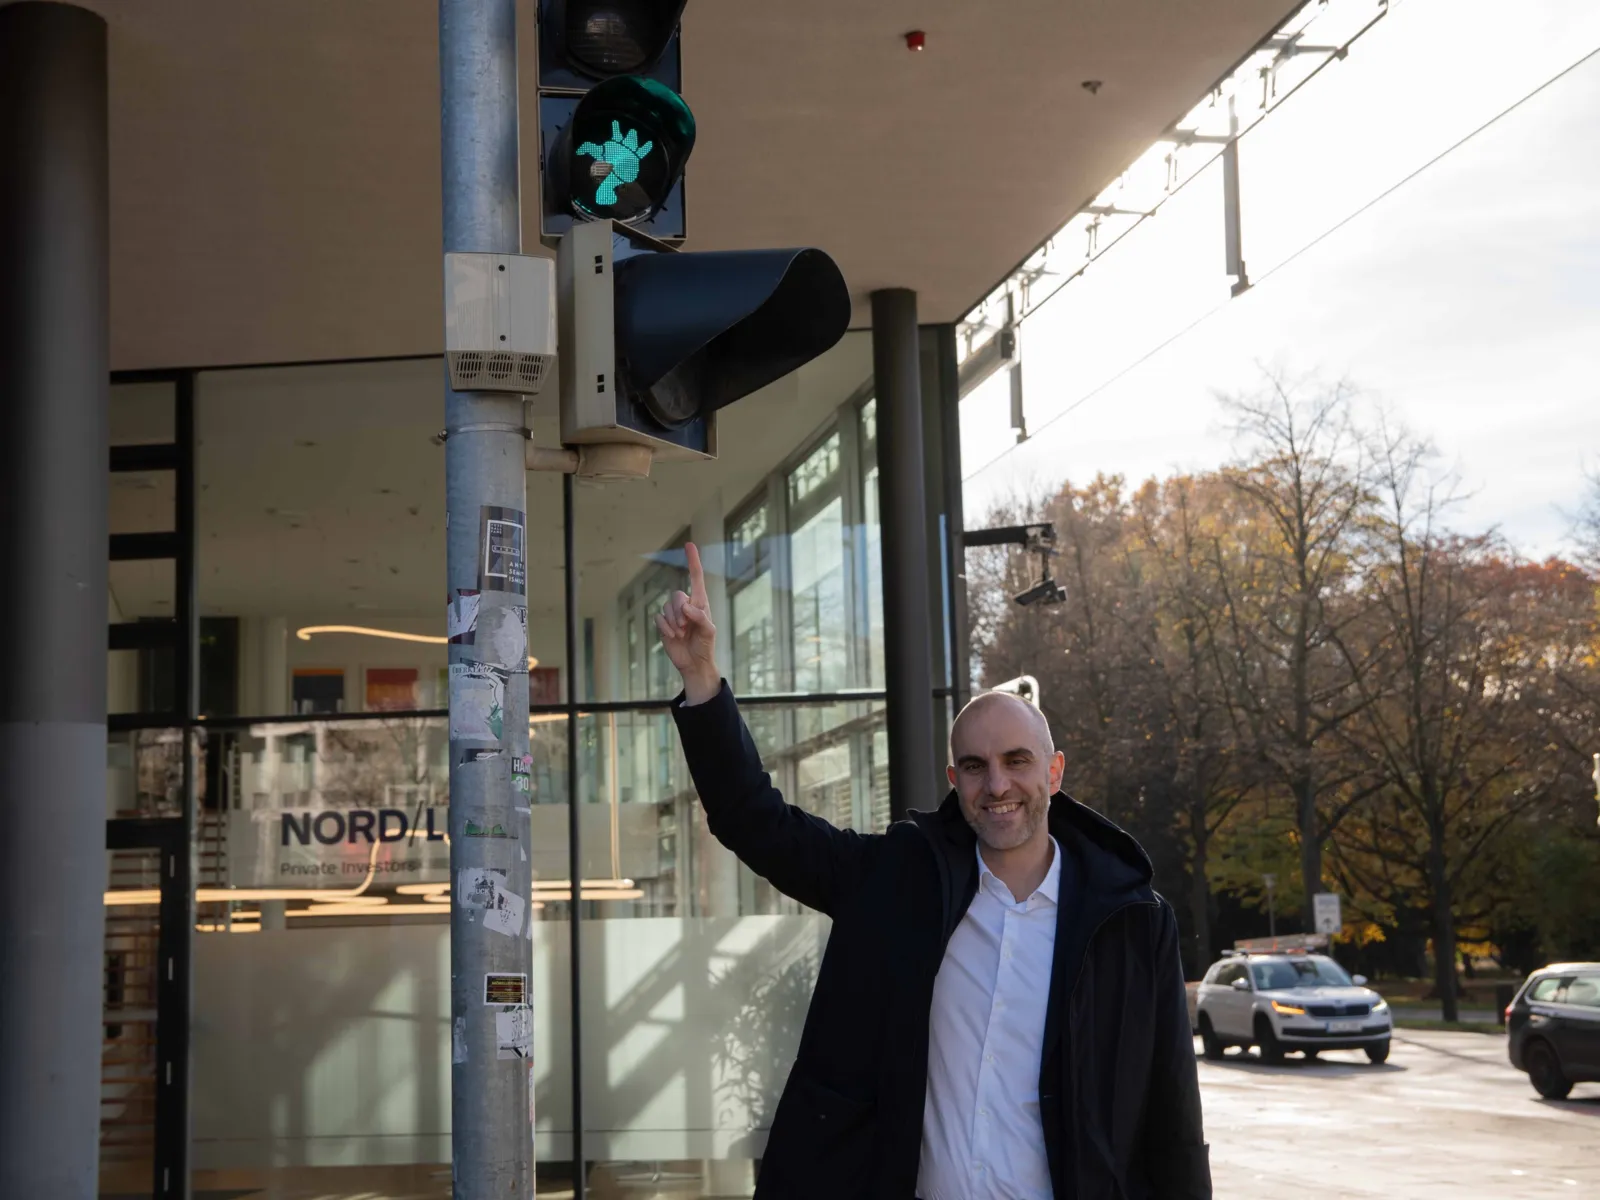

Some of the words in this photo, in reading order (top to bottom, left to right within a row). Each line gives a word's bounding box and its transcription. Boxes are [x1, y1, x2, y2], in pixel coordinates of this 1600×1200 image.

[281, 801, 450, 847] NORD/L
[280, 862, 336, 876] Private
[342, 859, 416, 874] Investors
